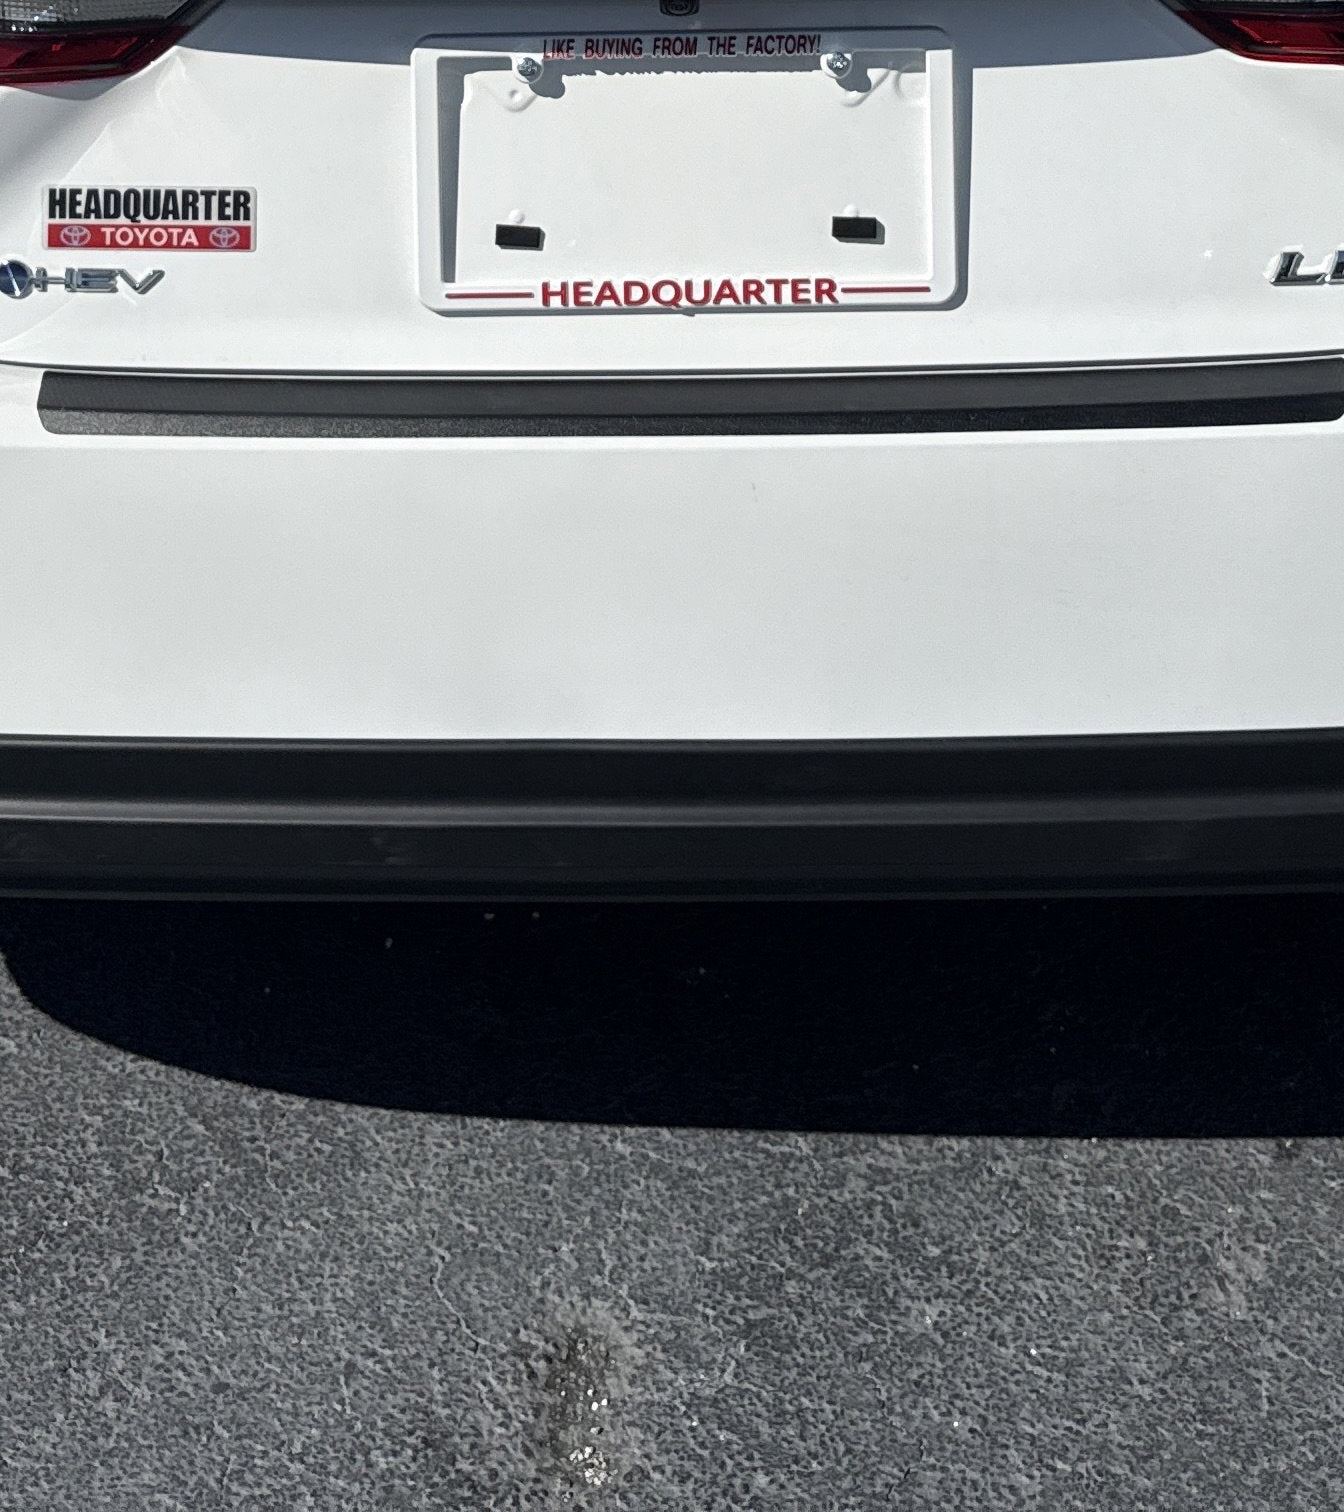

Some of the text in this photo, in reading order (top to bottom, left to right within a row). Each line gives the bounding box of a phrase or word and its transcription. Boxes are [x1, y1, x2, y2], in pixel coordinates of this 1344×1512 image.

[542, 33, 822, 59] LIKE BUYING FROM THE FACTORY!
[47, 187, 252, 223] HEADQUARTER
[100, 226, 200, 247] TOYOTA
[541, 277, 840, 309] HEADQUARTER
